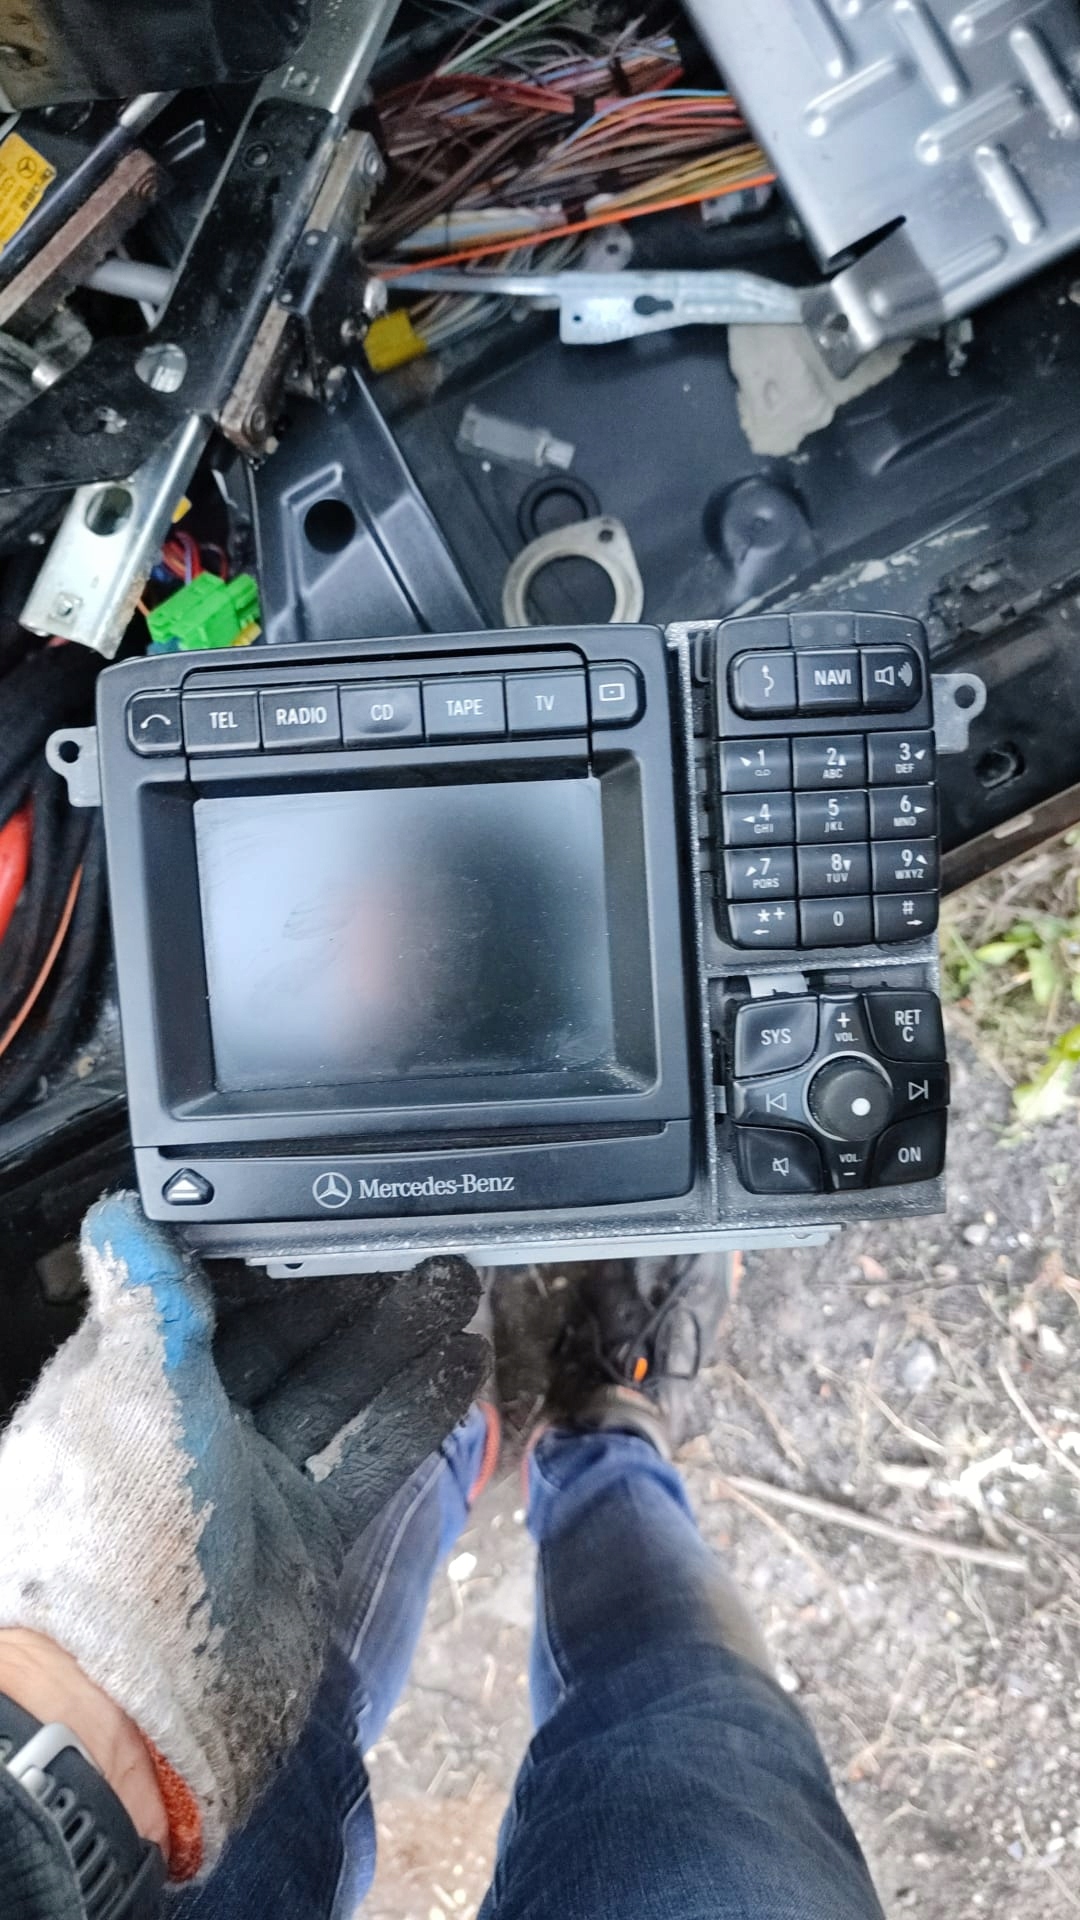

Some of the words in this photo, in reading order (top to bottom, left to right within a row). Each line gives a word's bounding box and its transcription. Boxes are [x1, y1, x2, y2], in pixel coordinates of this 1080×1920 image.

[814, 669, 852, 686] NAVI
[445, 698, 485, 717] TAPE
[535, 694, 555, 711] TV
[209, 711, 239, 729] TEL
[275, 706, 328, 726] RADIO
[370, 703, 394, 721] CD
[757, 749, 766, 766] 1
[826, 747, 838, 766] 2
[899, 742, 912, 761] 3
[822, 768, 844, 779] ABC
[895, 763, 916, 774] DEF
[759, 803, 771, 822] 4
[828, 798, 840, 817] 5
[900, 795, 912, 813] 6
[753, 823, 774, 834] GHI
[824, 821, 845, 833] JKL
[759, 858, 771, 876] 7
[831, 853, 842, 872] 8
[901, 849, 913, 867] 9
[826, 873, 849, 883] TUV
[832, 911, 844, 927] 0
[894, 1009, 922, 1027] RET
[760, 1028, 792, 1045] SYS
[902, 1027, 915, 1043] C
[898, 1147, 922, 1164] ON
[358, 1174, 515, 1200] Mercedes-Benz
